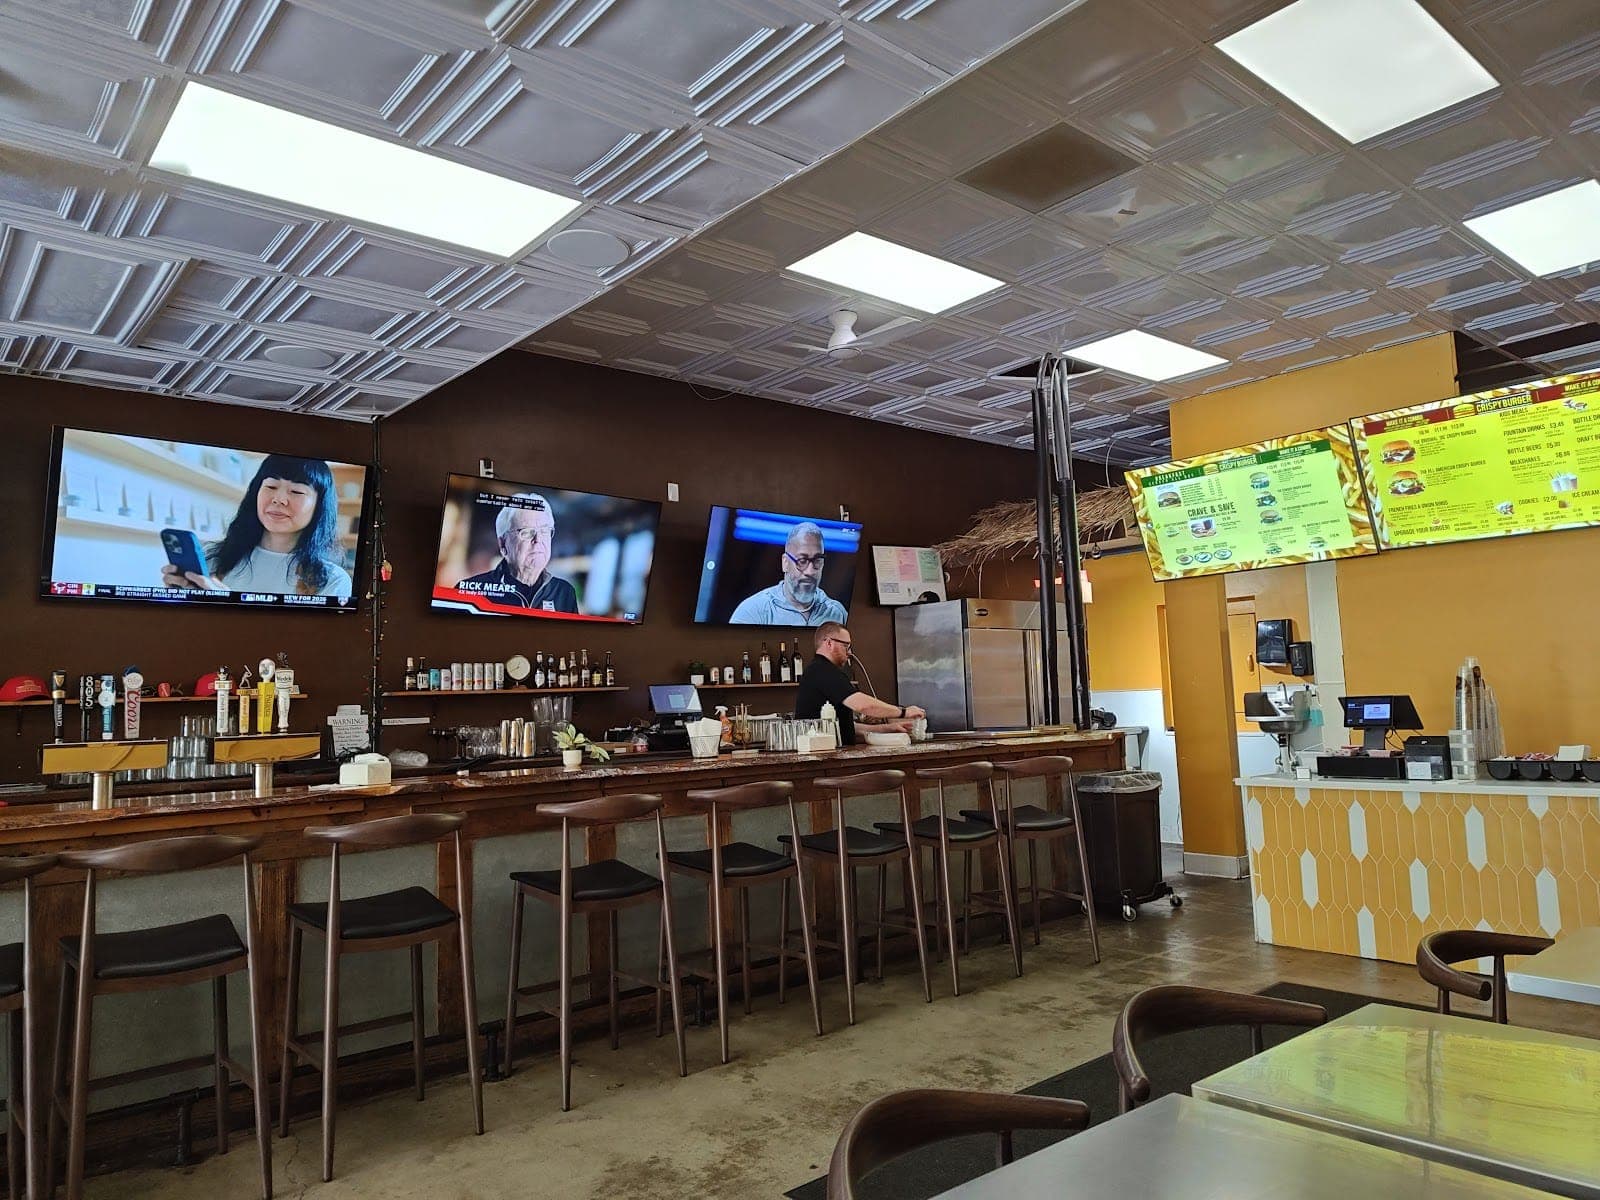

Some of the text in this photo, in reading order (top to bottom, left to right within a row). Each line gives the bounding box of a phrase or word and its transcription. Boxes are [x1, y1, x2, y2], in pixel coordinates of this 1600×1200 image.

[1476, 394, 1532, 412] CRISPY BURGER
[1512, 408, 1528, 416] MEALS
[1573, 416, 1592, 424] BOTTLE
[1504, 428, 1526, 436] FOUNTAIN
[1527, 424, 1546, 433] DRINKS
[1508, 446, 1525, 454] BOTTLE
[1510, 456, 1541, 466] MILKSHAKES
[1188, 506, 1208, 517] CRAVE
[1218, 502, 1236, 512] SAVE
[1394, 528, 1415, 536] UPGRADE
[460, 581, 516, 593] RICK MEARS
[85, 676, 94, 706] 805
[127, 690, 140, 730] Coors
